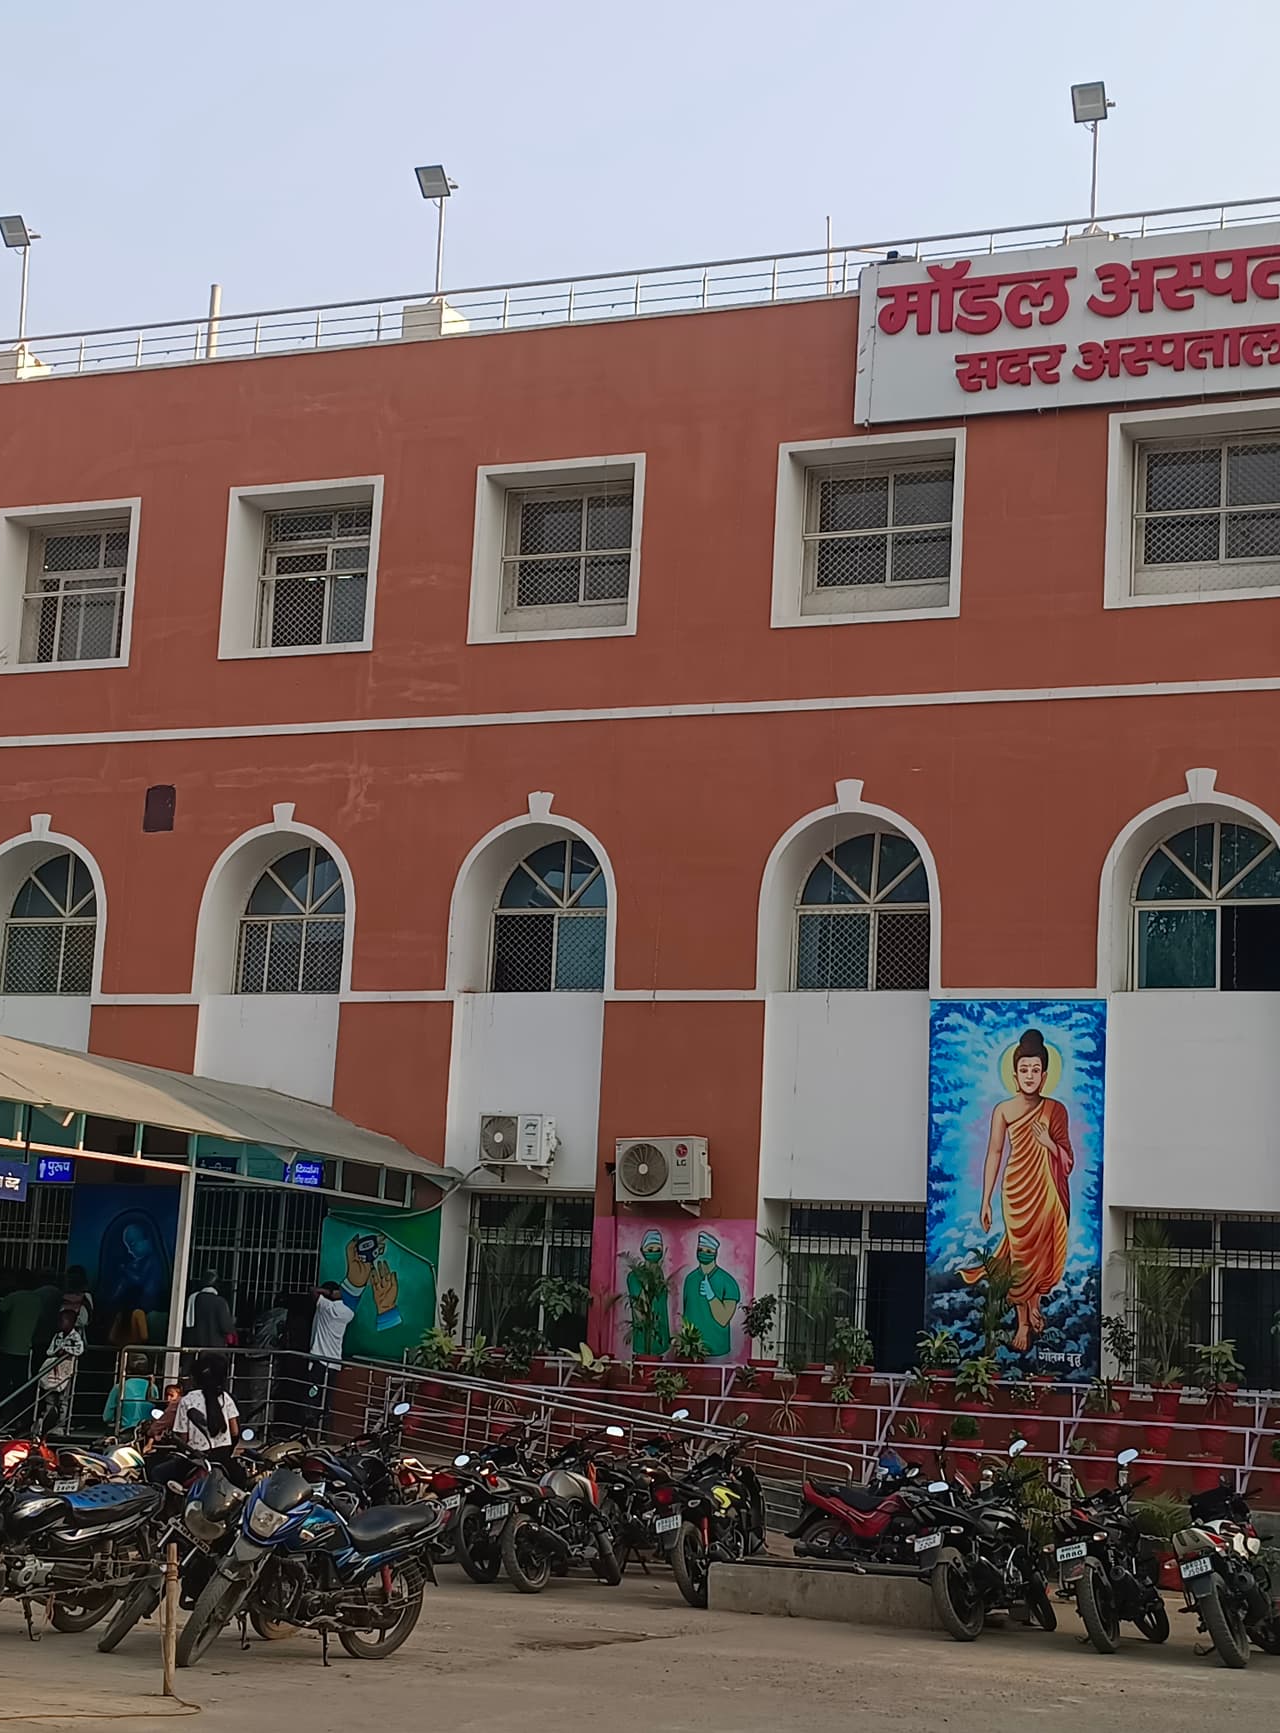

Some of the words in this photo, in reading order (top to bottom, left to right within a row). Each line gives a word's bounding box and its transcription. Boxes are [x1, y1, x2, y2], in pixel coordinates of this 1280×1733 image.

[877, 260, 1078, 337] मॉडल
[955, 343, 1068, 394] सदर
[676, 1158, 687, 1167] LG
